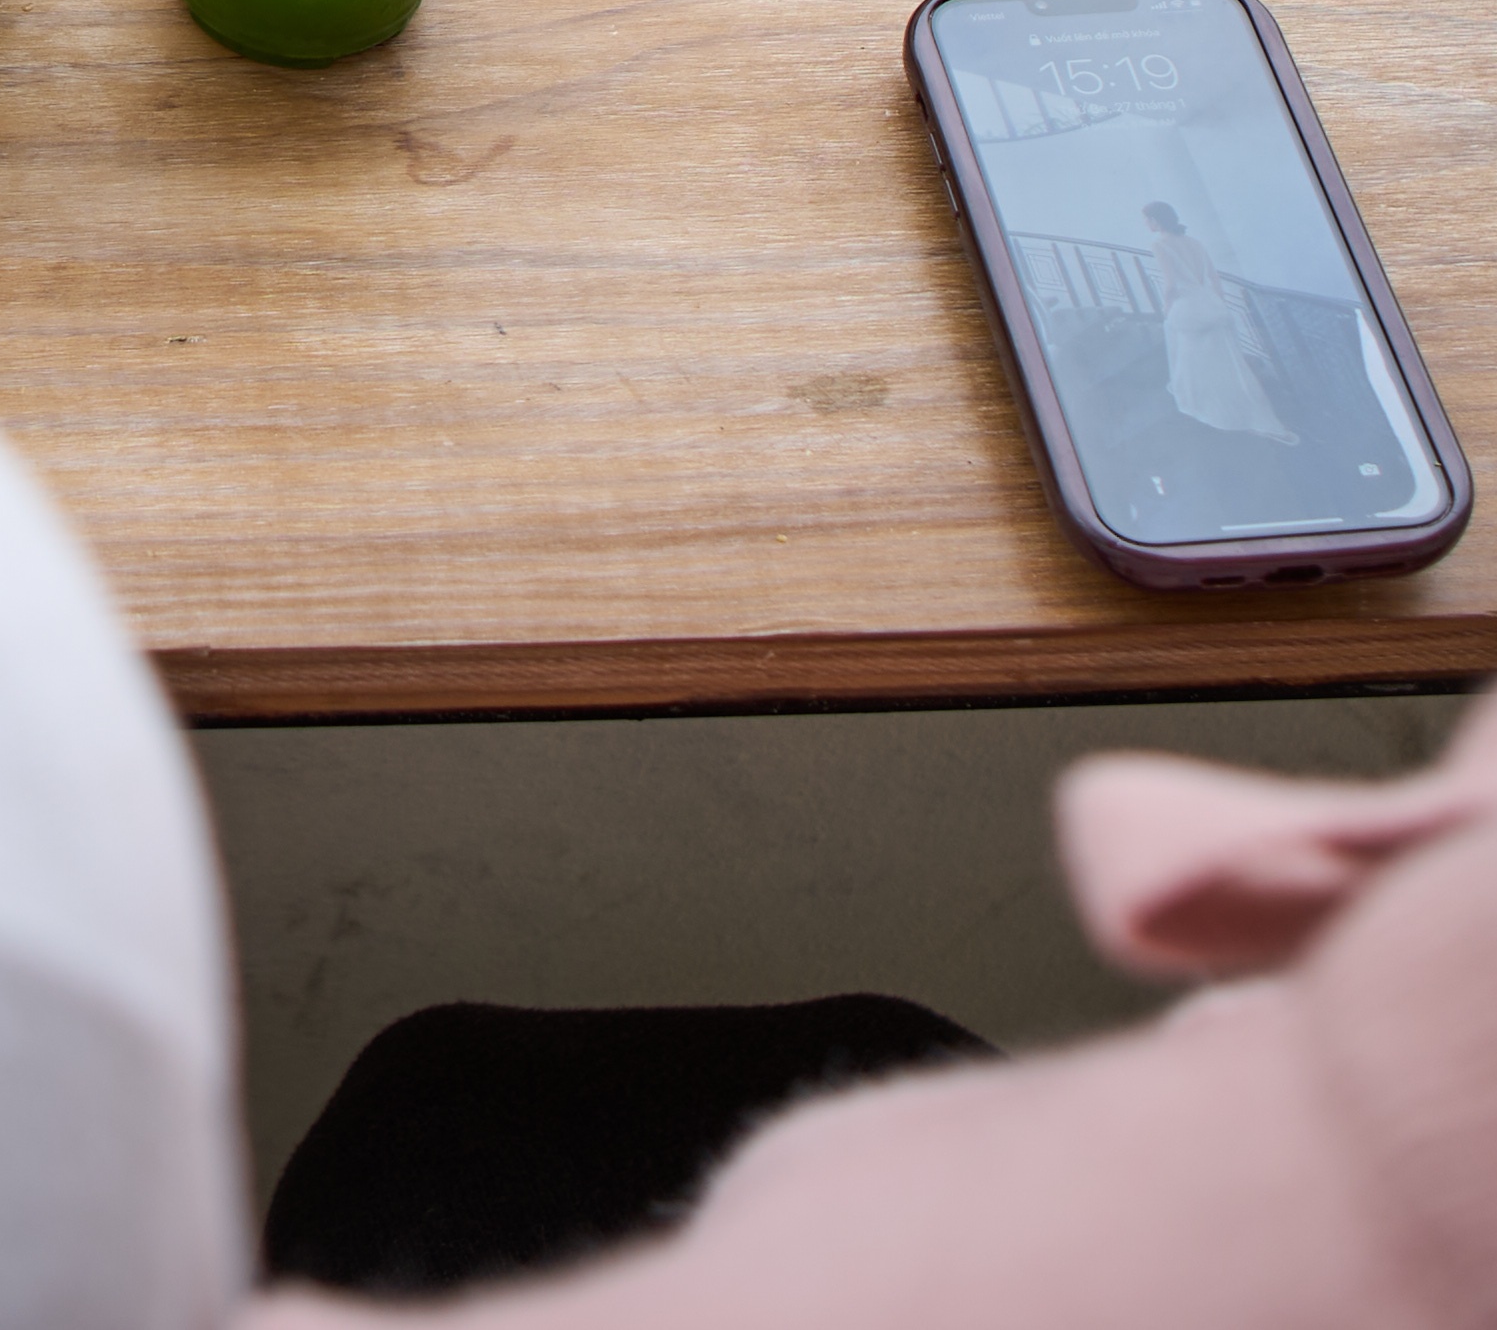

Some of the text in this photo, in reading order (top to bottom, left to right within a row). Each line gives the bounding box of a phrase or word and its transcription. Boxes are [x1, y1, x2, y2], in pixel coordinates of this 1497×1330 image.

[969, 11, 1005, 22] Viettel
[1038, 53, 1179, 97] 15:19
[1113, 101, 1131, 113] 27
[1134, 99, 1176, 112] tháng
